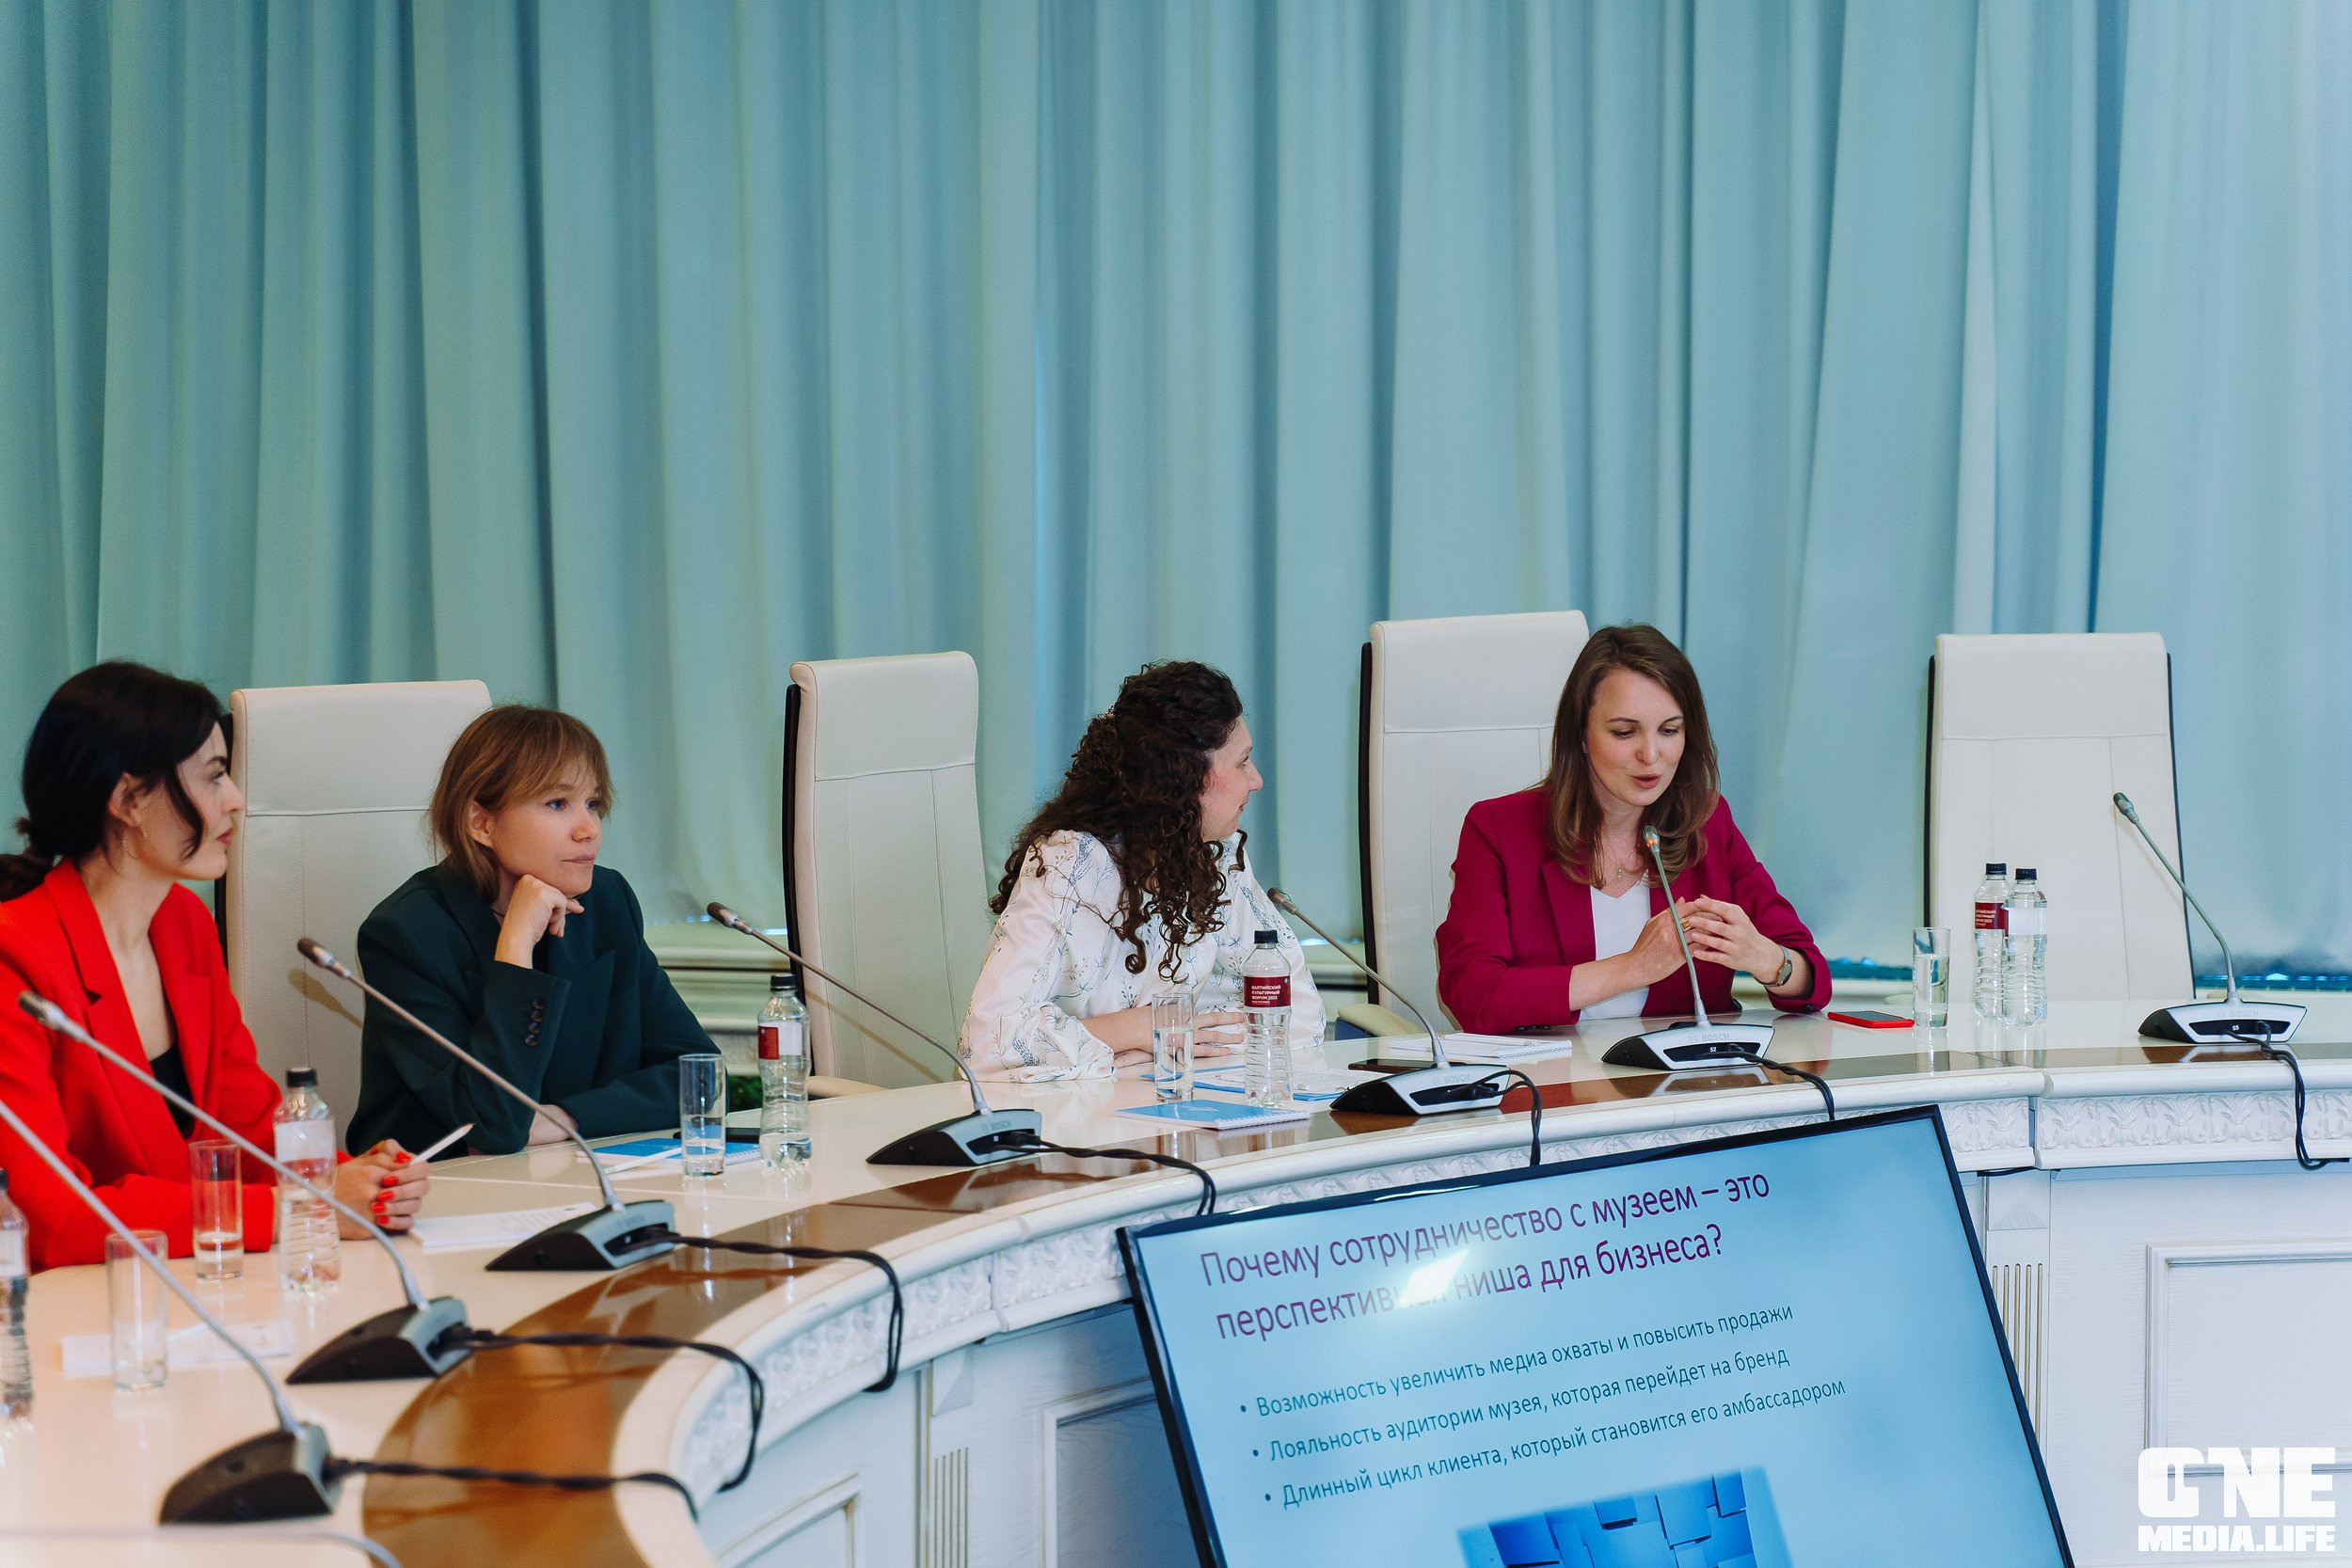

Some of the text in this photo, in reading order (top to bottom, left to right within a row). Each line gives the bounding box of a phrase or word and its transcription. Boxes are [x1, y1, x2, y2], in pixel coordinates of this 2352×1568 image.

[1444, 1074, 1470, 1083] BOSCH
[1701, 1033, 1730, 1041] BOSCH
[1200, 1245, 1319, 1286] Почему
[1329, 1207, 1562, 1266] сотрудничество
[1570, 1203, 1586, 1227] с
[1592, 1186, 1697, 1228] музеем
[1724, 1174, 1769, 1202] это
[1454, 1264, 1532, 1300] ниша
[1541, 1255, 1591, 1292] для
[1596, 1224, 1722, 1275] бизнеса?
[1256, 1307, 1793, 1417] Возможность увеличить медиа охваты и повысить продажи
[1271, 1350, 1790, 1461] Лояльность аудитории музея, которая перейдет на бренд
[1283, 1381, 1845, 1510] Длинный цикл клиента, который становится его амбассадором
